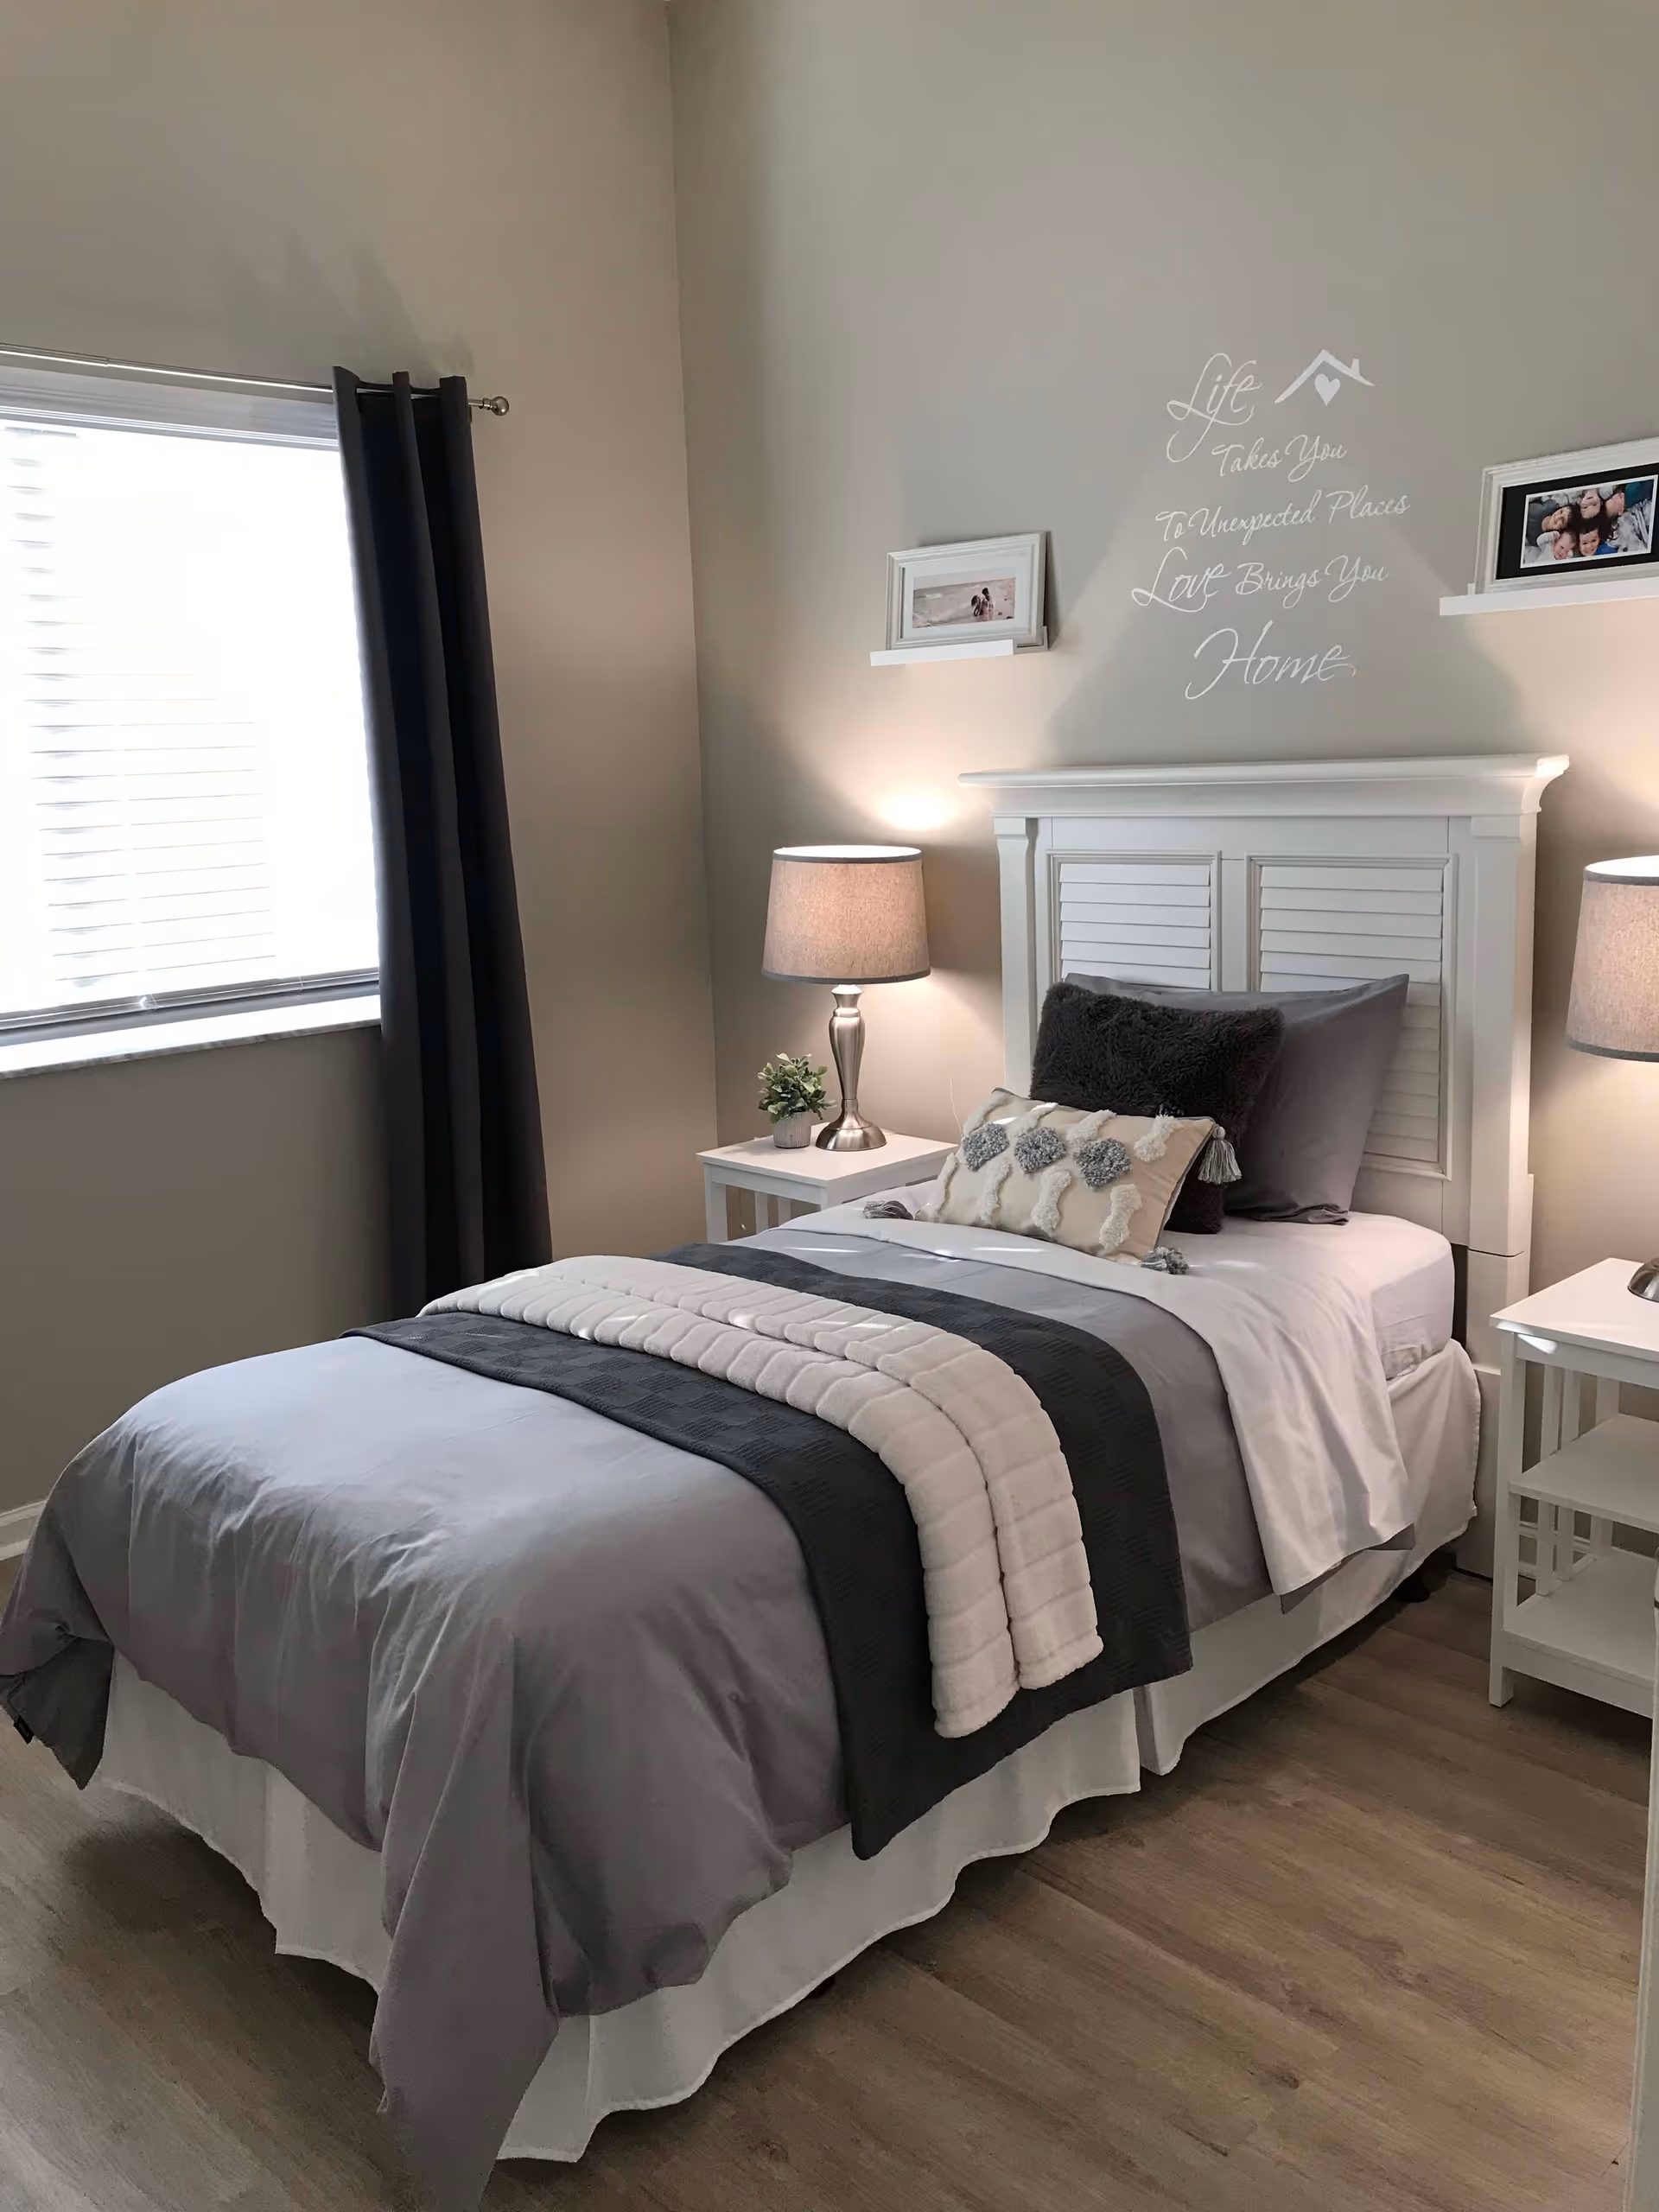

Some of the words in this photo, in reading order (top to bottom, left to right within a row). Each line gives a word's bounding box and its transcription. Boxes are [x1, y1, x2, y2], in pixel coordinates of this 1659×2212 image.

[1166, 353, 1263, 462] Life
[1211, 436, 1282, 477] Takes
[1284, 434, 1349, 482] You
[1154, 510, 1187, 542] To
[1187, 489, 1324, 546] Unexpected
[1325, 484, 1411, 524] Places
[1130, 546, 1231, 613] Love
[1235, 562, 1321, 609] Brings
[1325, 554, 1389, 603] You
[1185, 619, 1357, 700] Home
